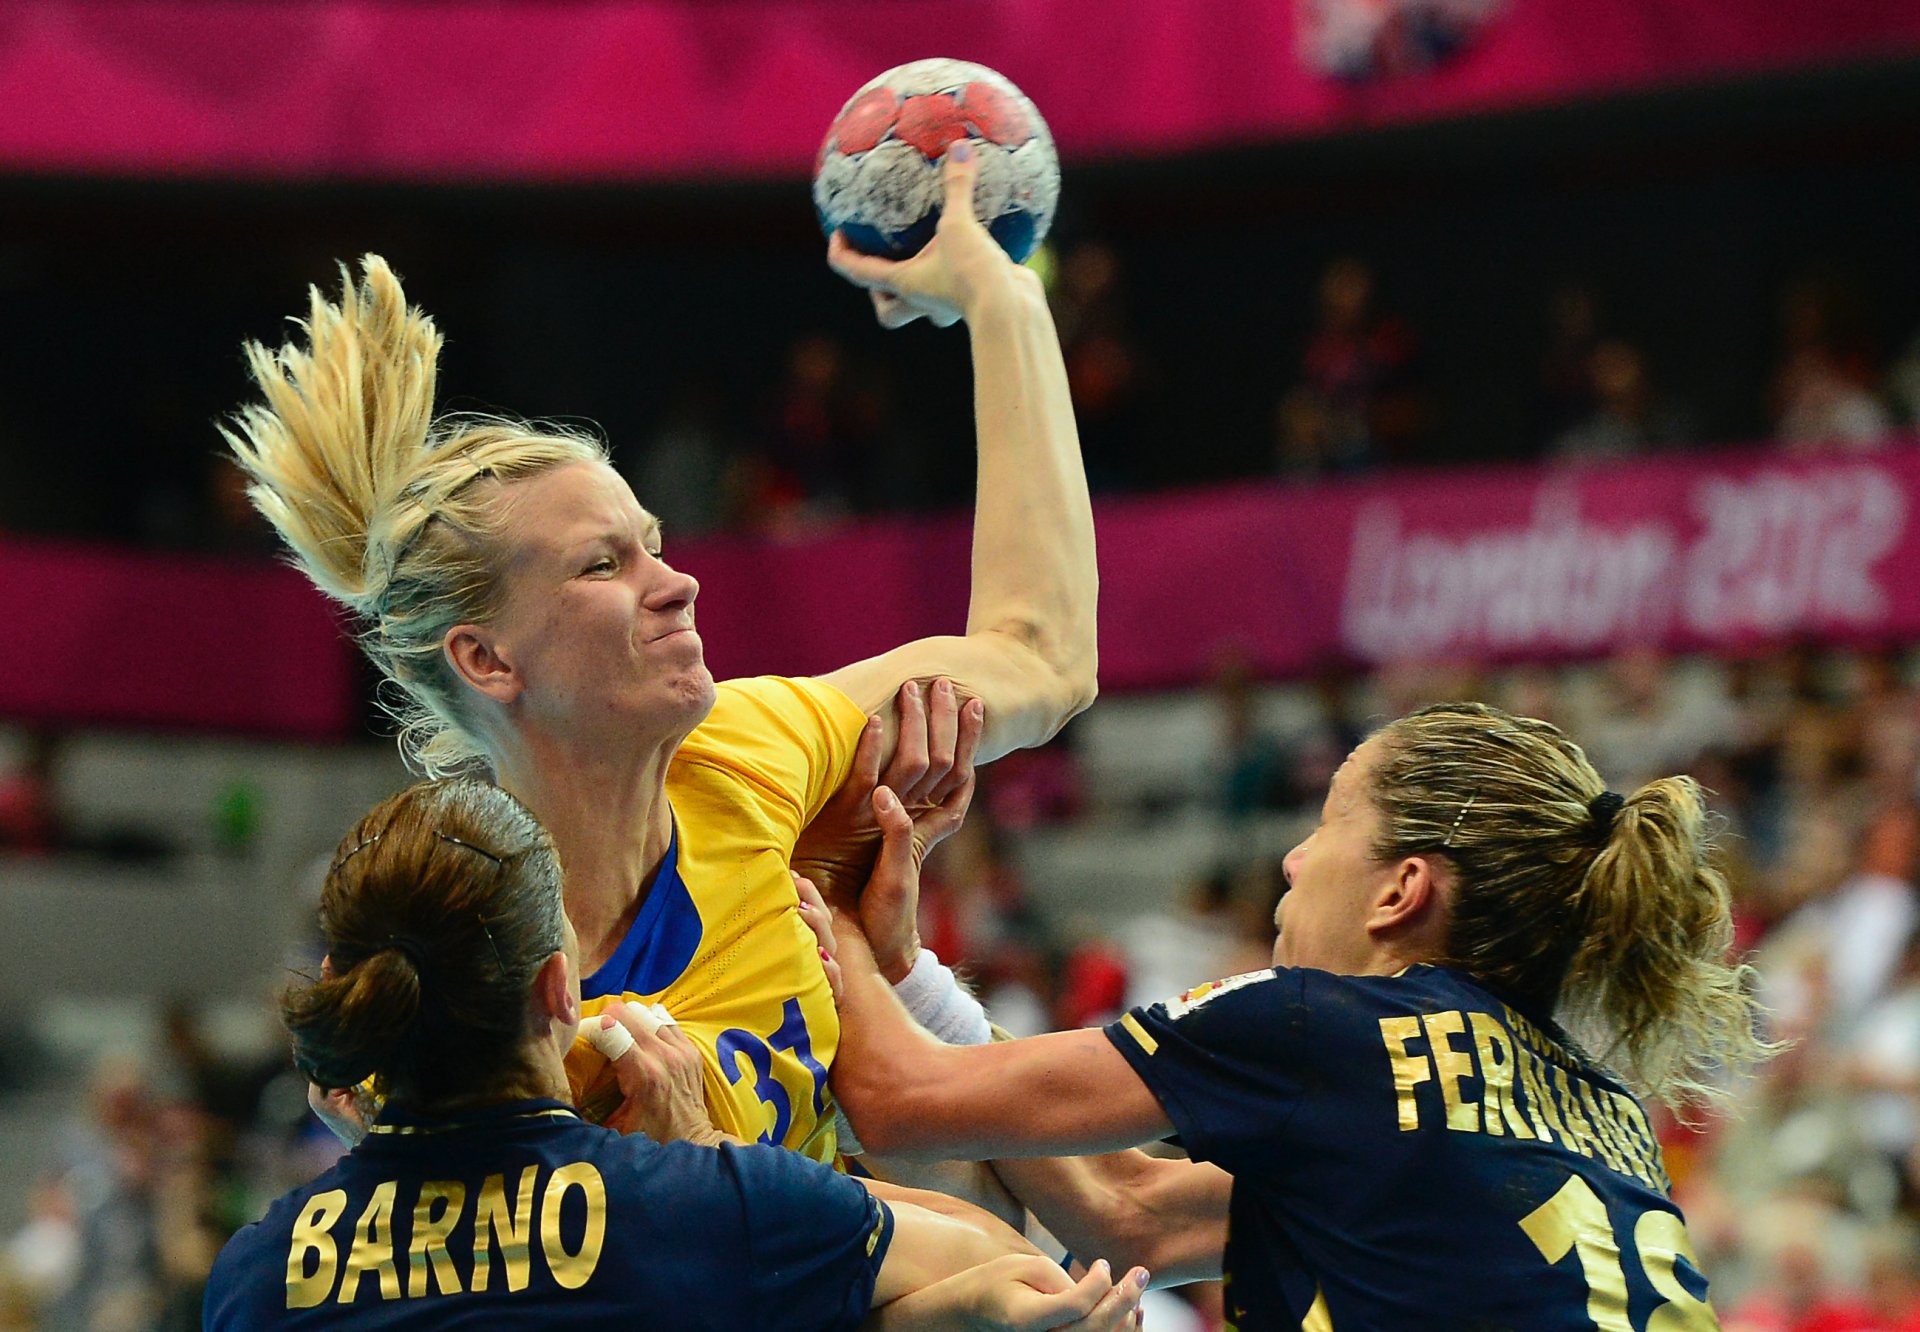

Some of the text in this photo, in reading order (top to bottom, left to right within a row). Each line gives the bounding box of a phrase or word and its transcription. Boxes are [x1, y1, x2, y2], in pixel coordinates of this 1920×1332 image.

[1685, 467, 1902, 630] 2012
[715, 996, 828, 1148] 31
[285, 1161, 607, 1310] BARNO
